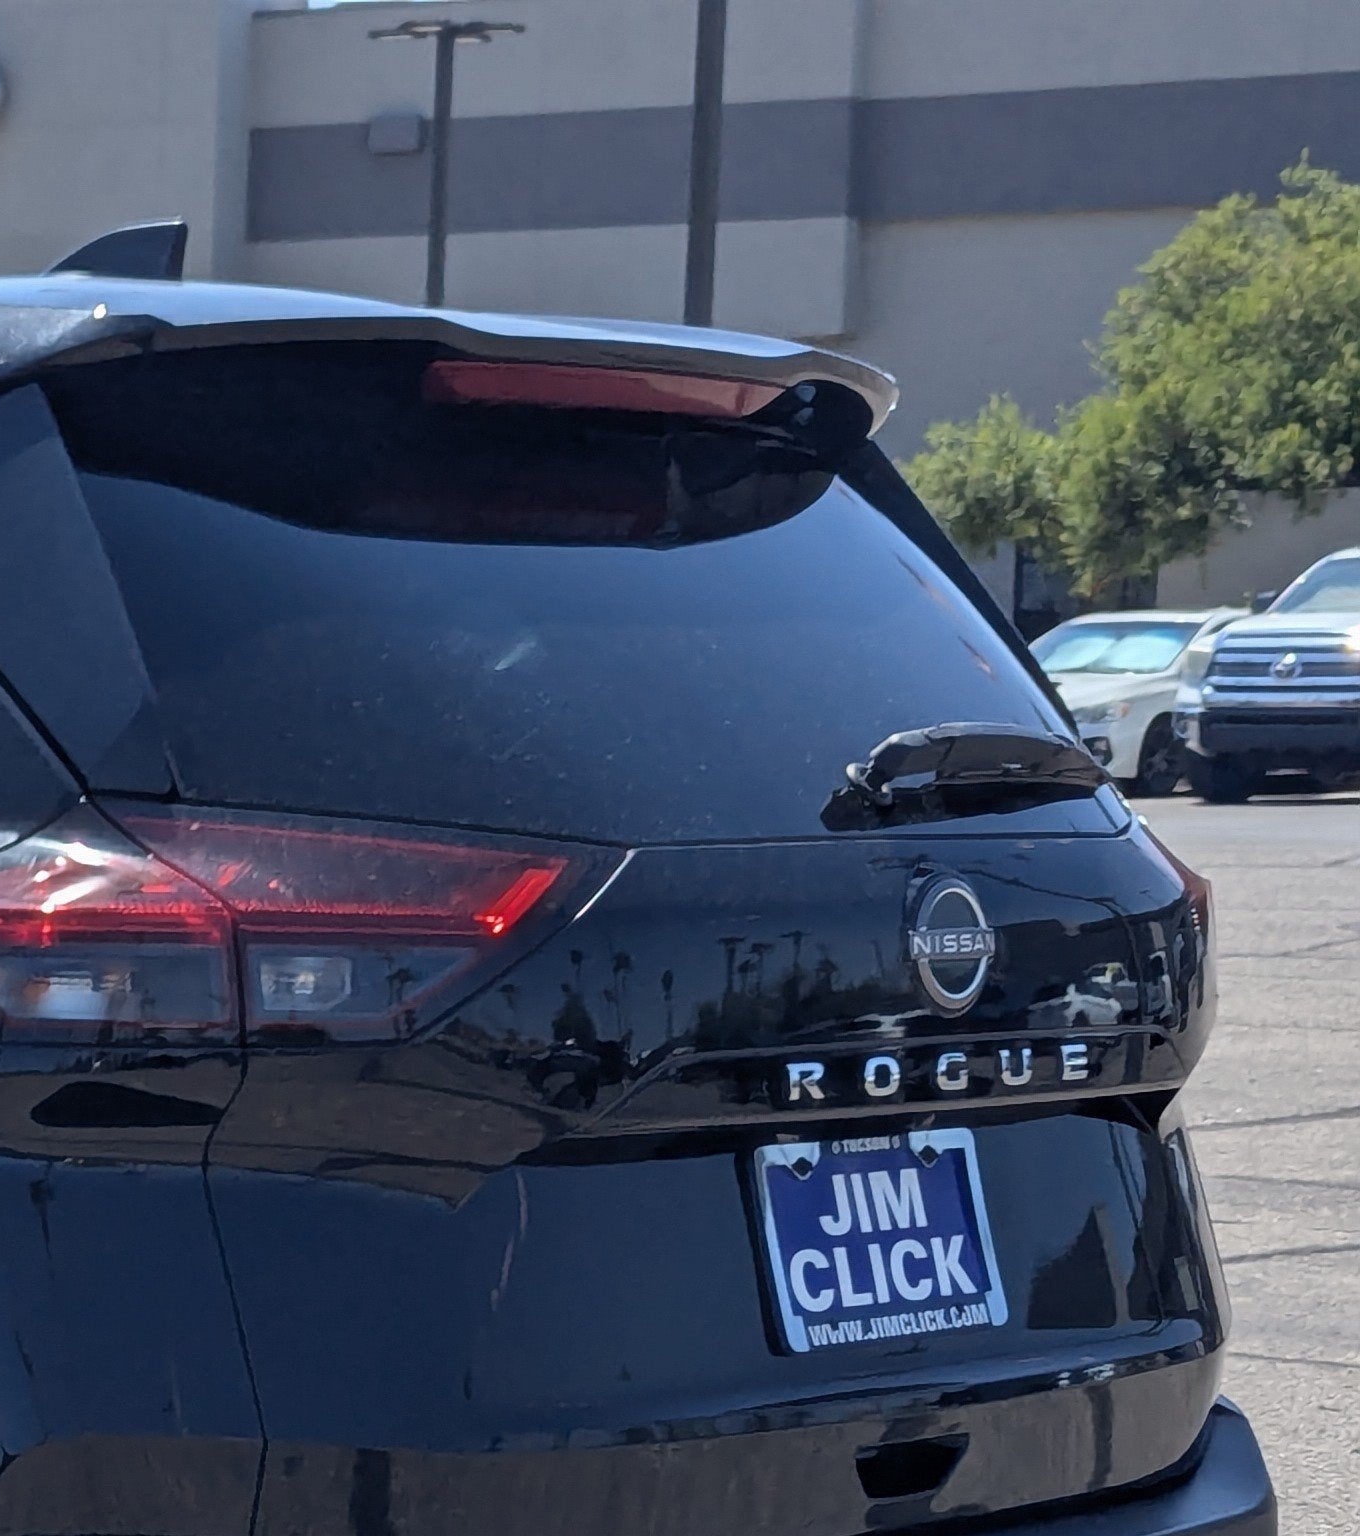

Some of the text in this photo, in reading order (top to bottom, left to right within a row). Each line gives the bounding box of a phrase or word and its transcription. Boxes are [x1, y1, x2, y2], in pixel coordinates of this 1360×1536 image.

[913, 933, 995, 954] NISSAN
[787, 1044, 1089, 1100] ROGUE
[819, 1168, 928, 1236] JIM
[789, 1234, 978, 1313] CLICK
